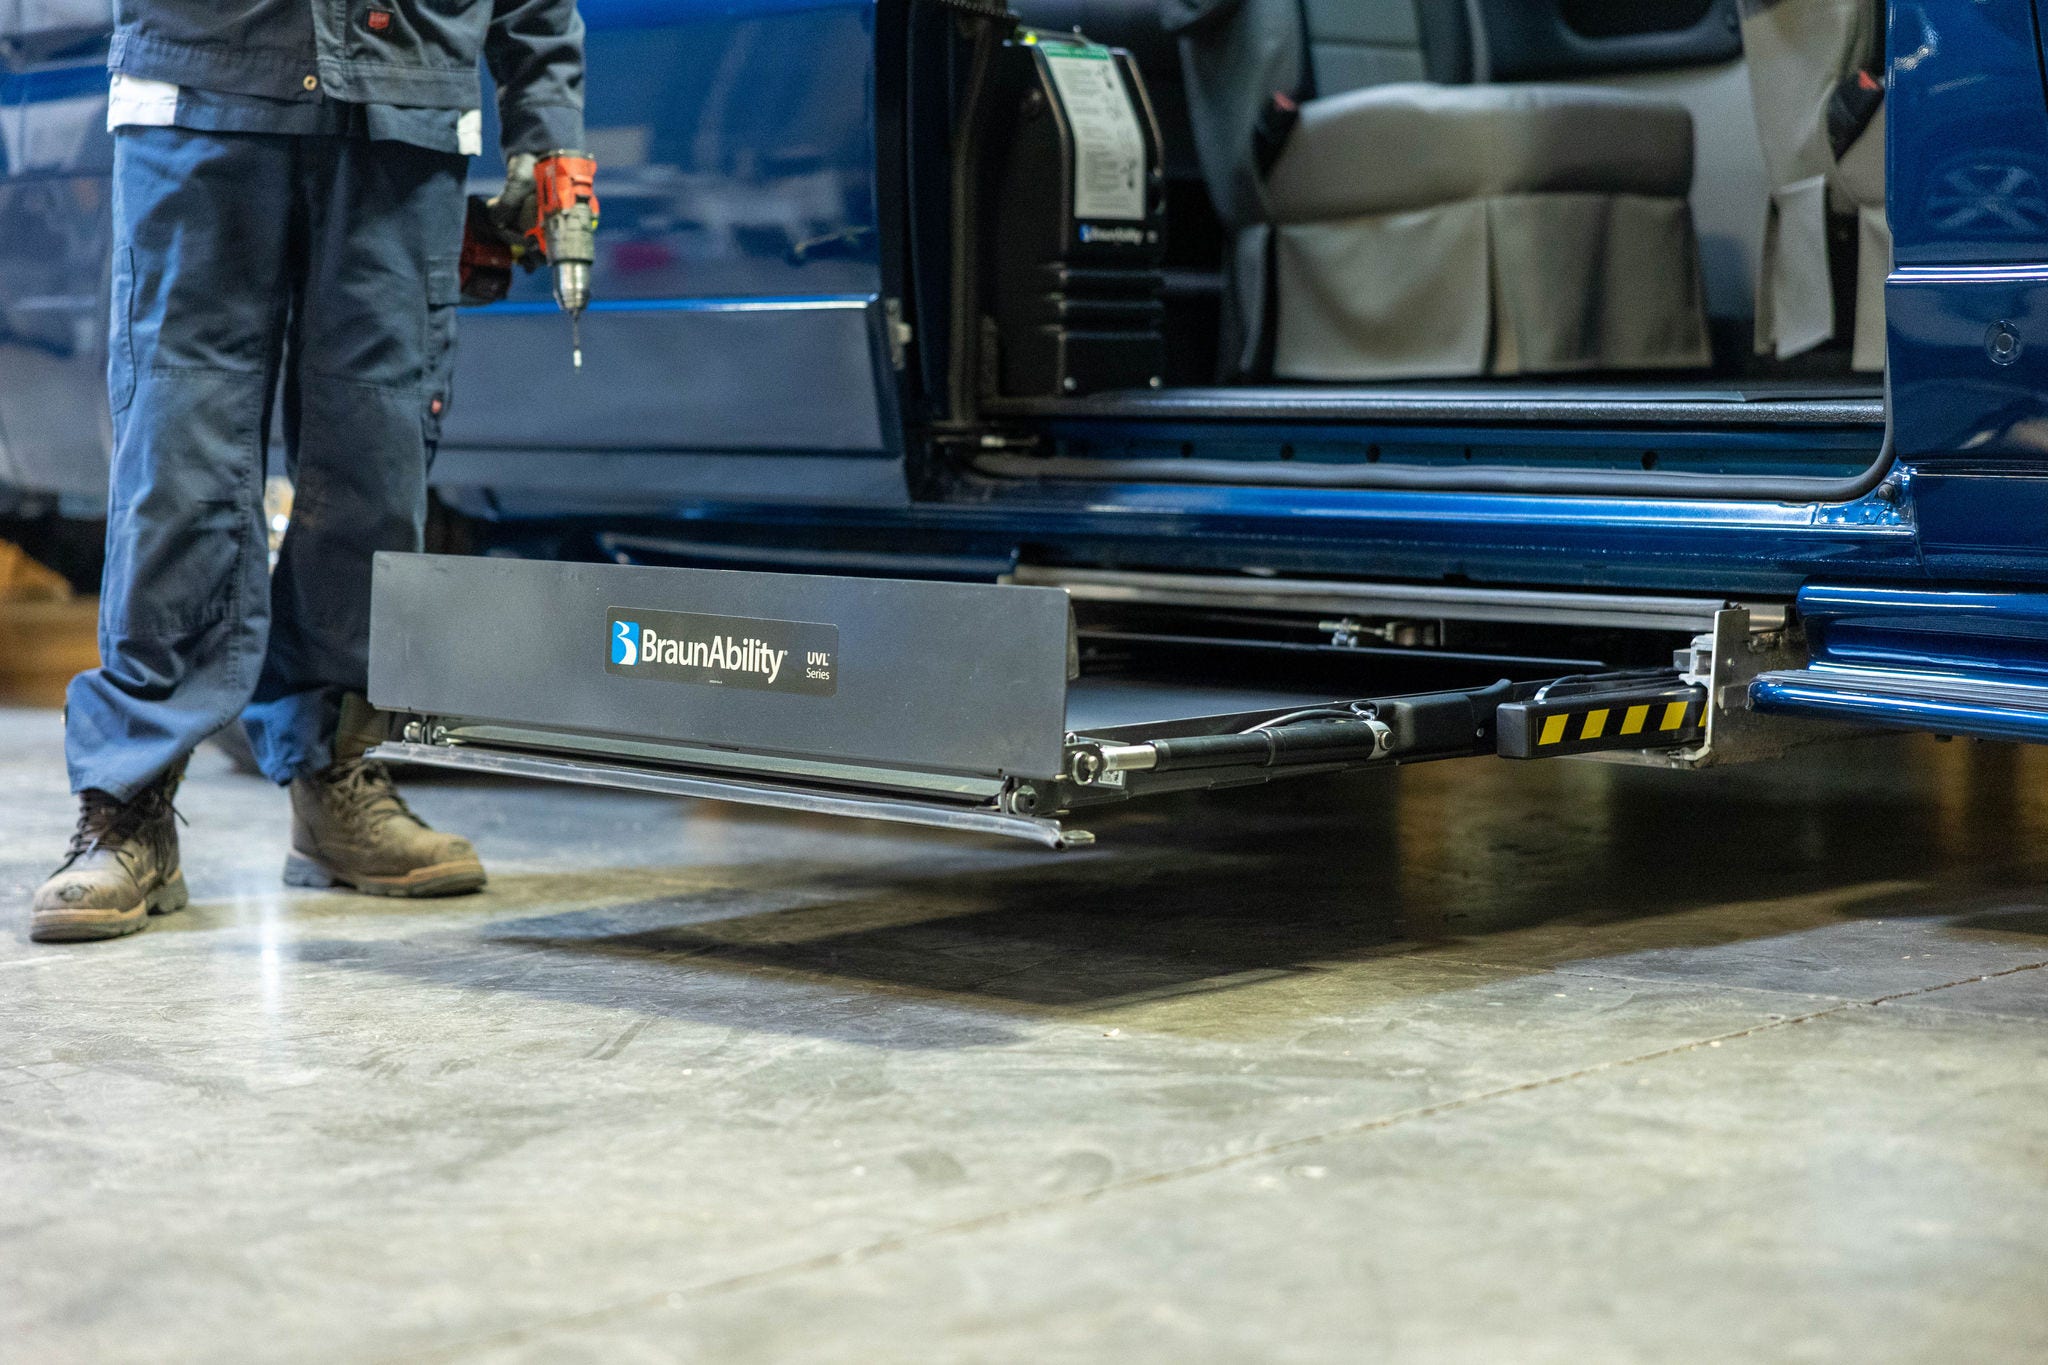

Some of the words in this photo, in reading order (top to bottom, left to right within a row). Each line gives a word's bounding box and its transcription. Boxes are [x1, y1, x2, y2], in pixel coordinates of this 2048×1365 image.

[641, 629, 785, 684] BraunAbility
[807, 651, 829, 666] UVL
[806, 667, 830, 680] Series
